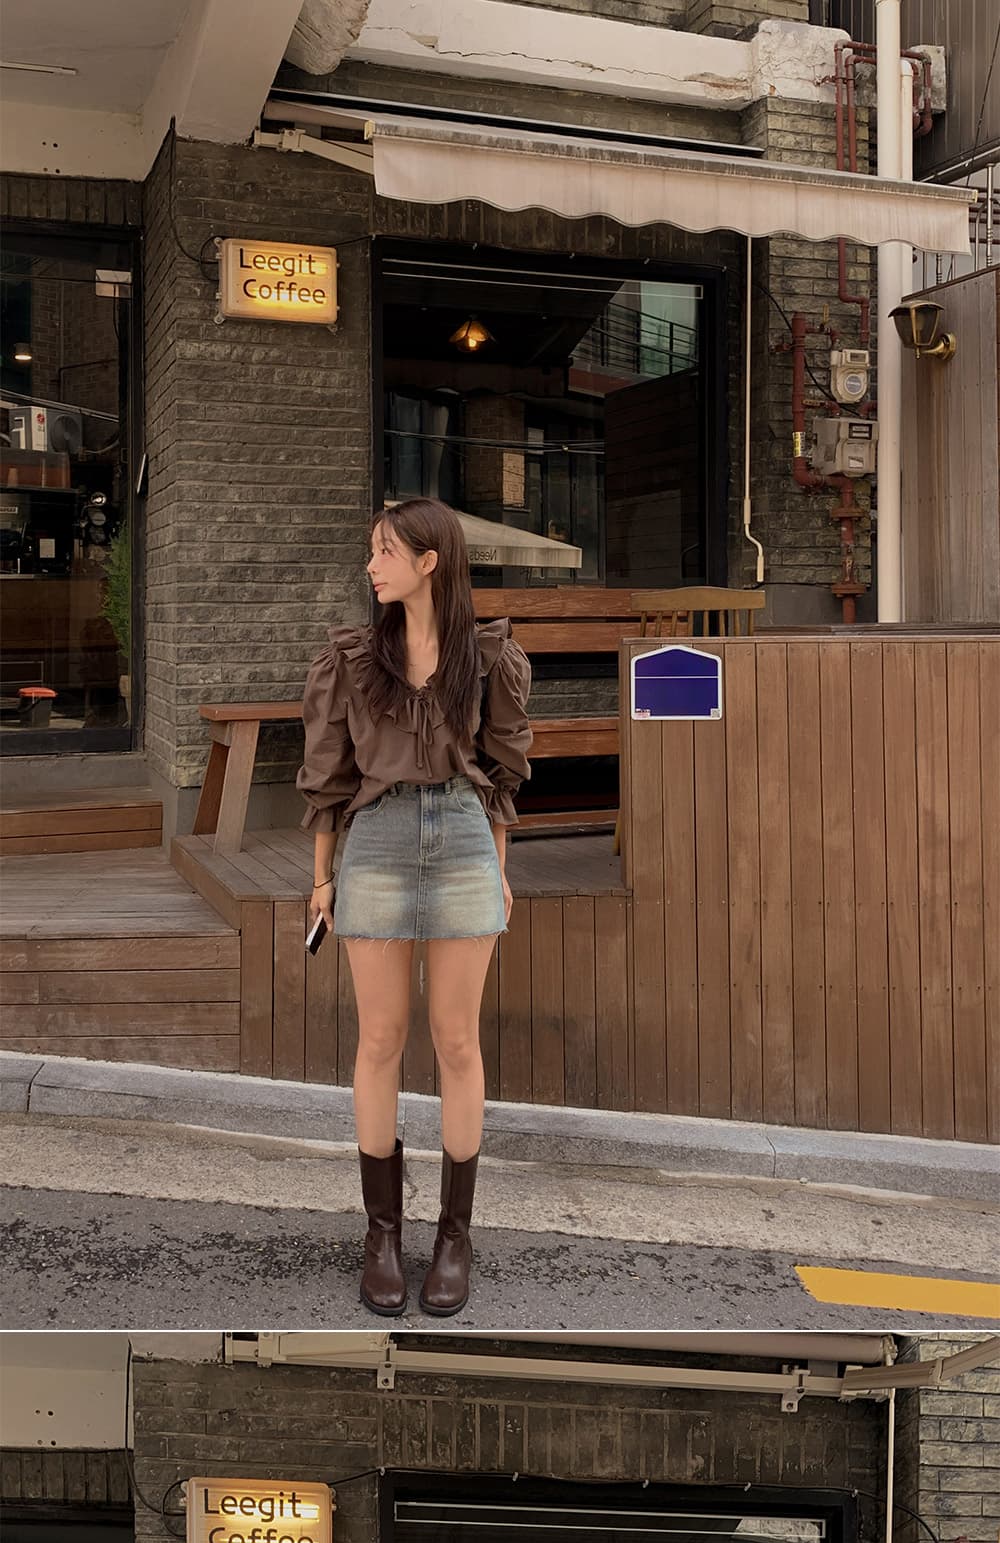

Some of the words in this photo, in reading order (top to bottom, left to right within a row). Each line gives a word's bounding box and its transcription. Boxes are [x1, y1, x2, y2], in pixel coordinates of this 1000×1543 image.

[240, 248, 316, 277] Leegit
[243, 279, 326, 304] Coffee
[204, 1489, 302, 1522] Leegit
